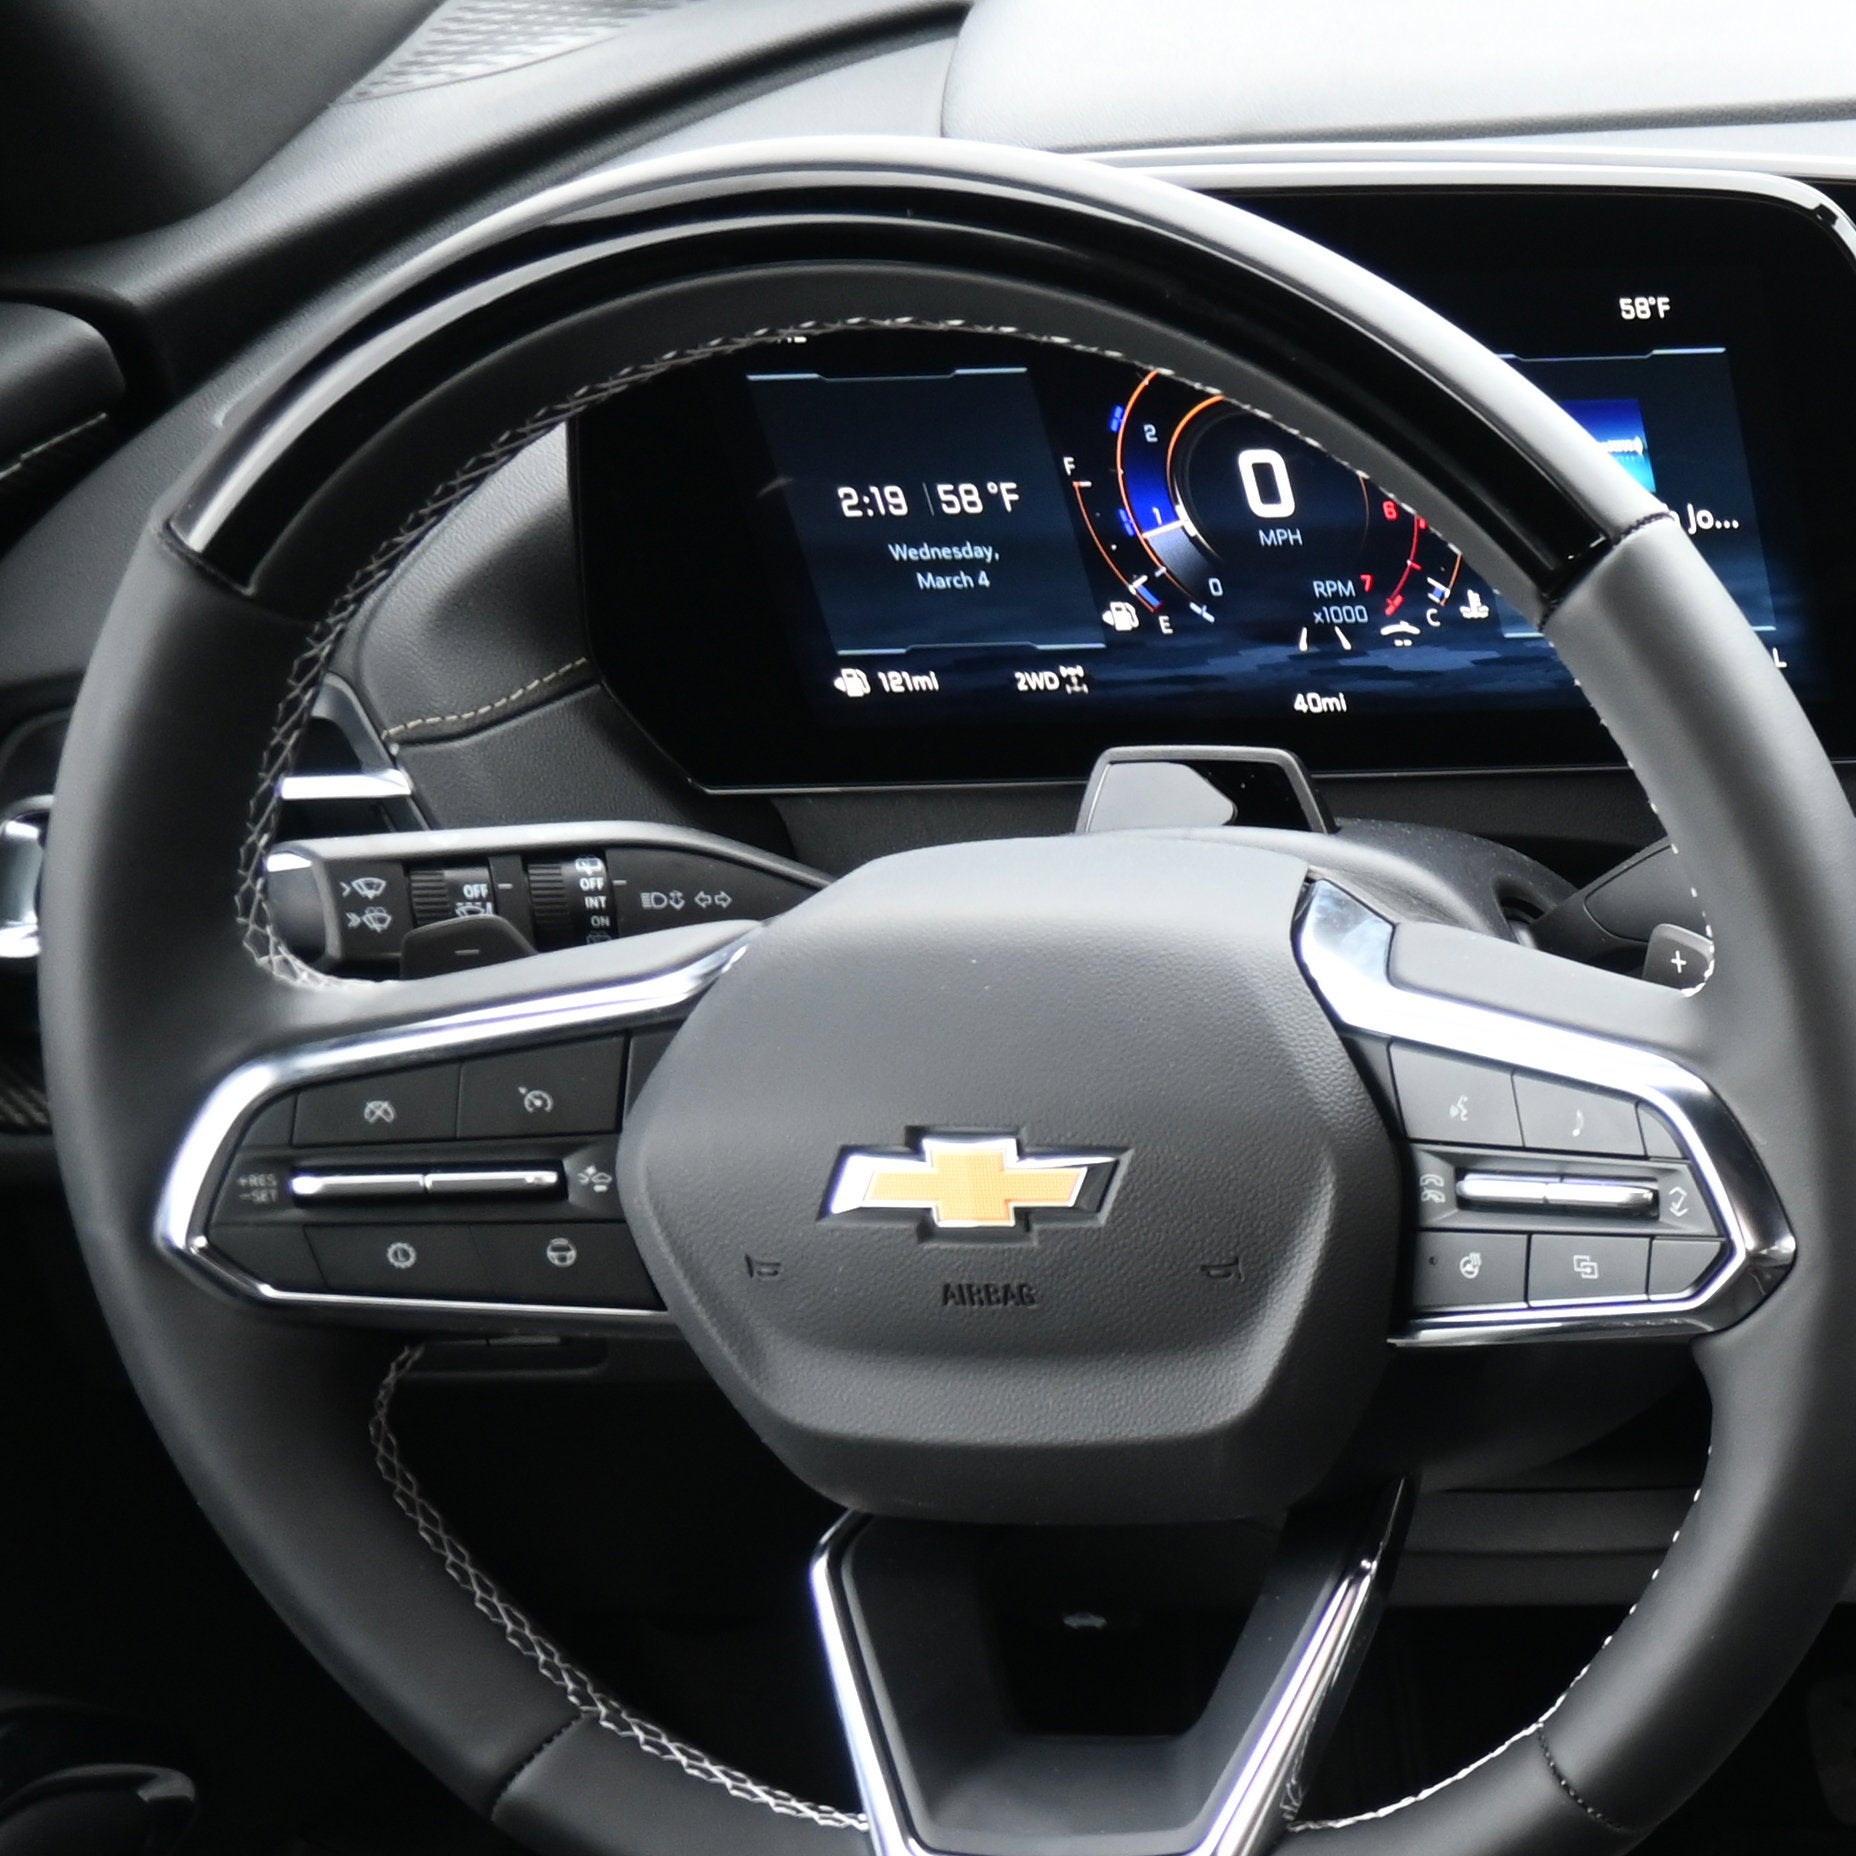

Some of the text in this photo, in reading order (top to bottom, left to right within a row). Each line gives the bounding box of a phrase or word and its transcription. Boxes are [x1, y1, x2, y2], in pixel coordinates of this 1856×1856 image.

[1618, 296, 1671, 320] 58°F
[1143, 423, 1158, 443] 2
[1063, 456, 1076, 476] F
[1237, 448, 1296, 519] 0
[837, 485, 908, 518] 2:19
[936, 482, 984, 514] 58
[1153, 508, 1163, 524] 1
[1382, 500, 1399, 521] 6
[1258, 528, 1303, 546] MPH
[887, 540, 1000, 563] Wednesday,
[916, 570, 991, 590] March 4
[1208, 577, 1224, 597] 0
[1312, 579, 1356, 598] RPM
[1360, 574, 1373, 592] 7
[1313, 604, 1369, 624] x1000
[1425, 607, 1441, 627] C
[1158, 615, 1174, 635] E
[1772, 648, 1788, 668] L
[877, 670, 940, 693] 121mi
[1014, 670, 1060, 692] 2WD
[1293, 691, 1347, 714] 40mi
[462, 883, 489, 899] OFF
[579, 873, 605, 891] OFF
[584, 895, 607, 909] INT
[590, 915, 610, 927] ON
[942, 1282, 1036, 1307] AIRBAG
